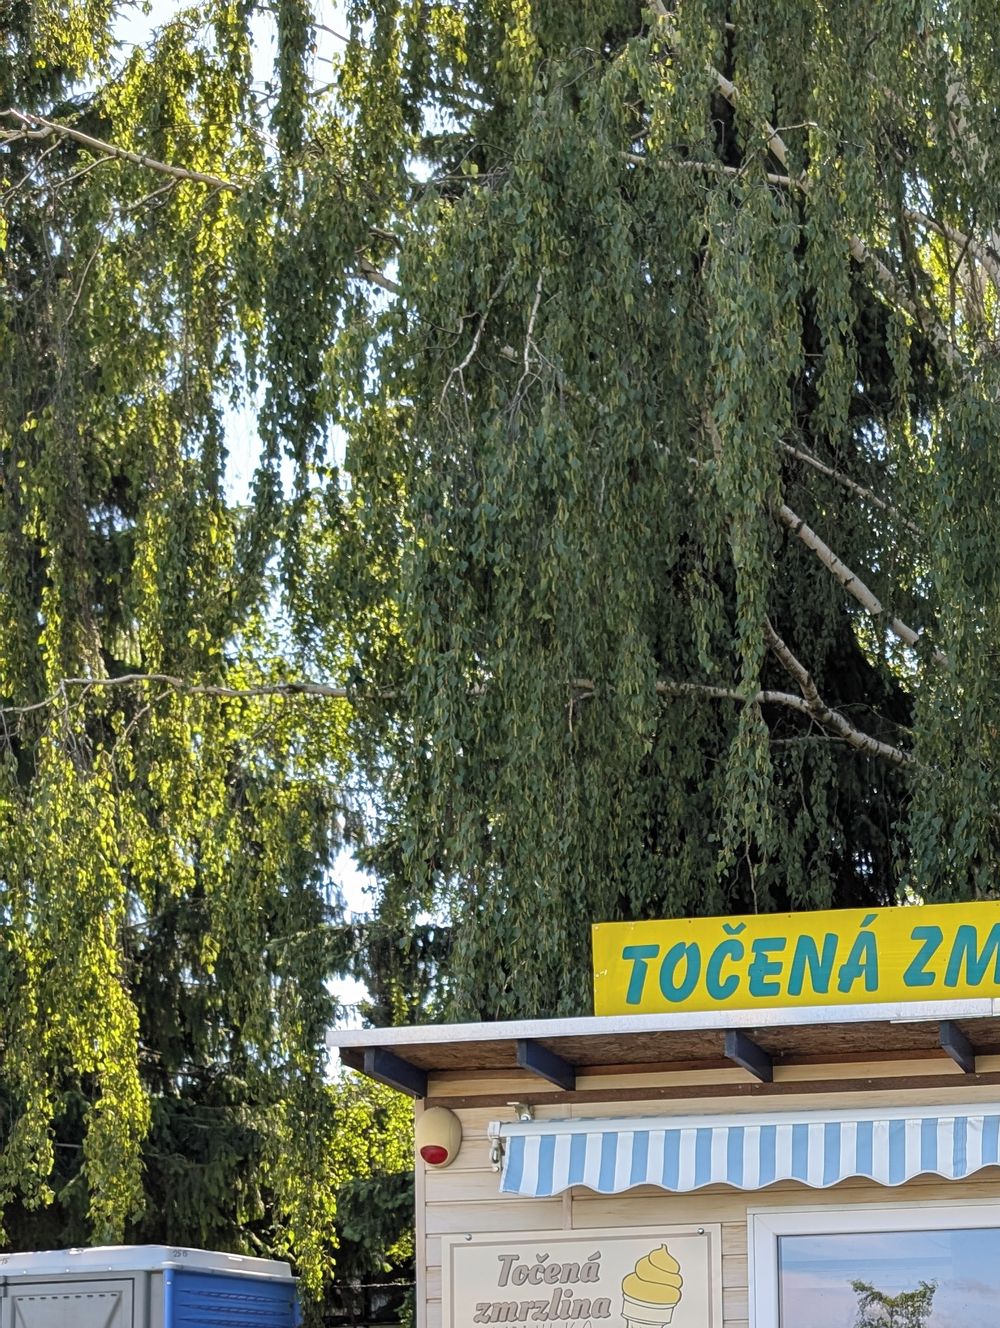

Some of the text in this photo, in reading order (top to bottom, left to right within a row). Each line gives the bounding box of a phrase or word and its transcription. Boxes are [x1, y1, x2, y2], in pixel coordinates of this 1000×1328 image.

[621, 914, 879, 1005] TOČENÁ
[497, 1251, 601, 1287] Točená
[473, 1288, 611, 1324] zmrzlina
